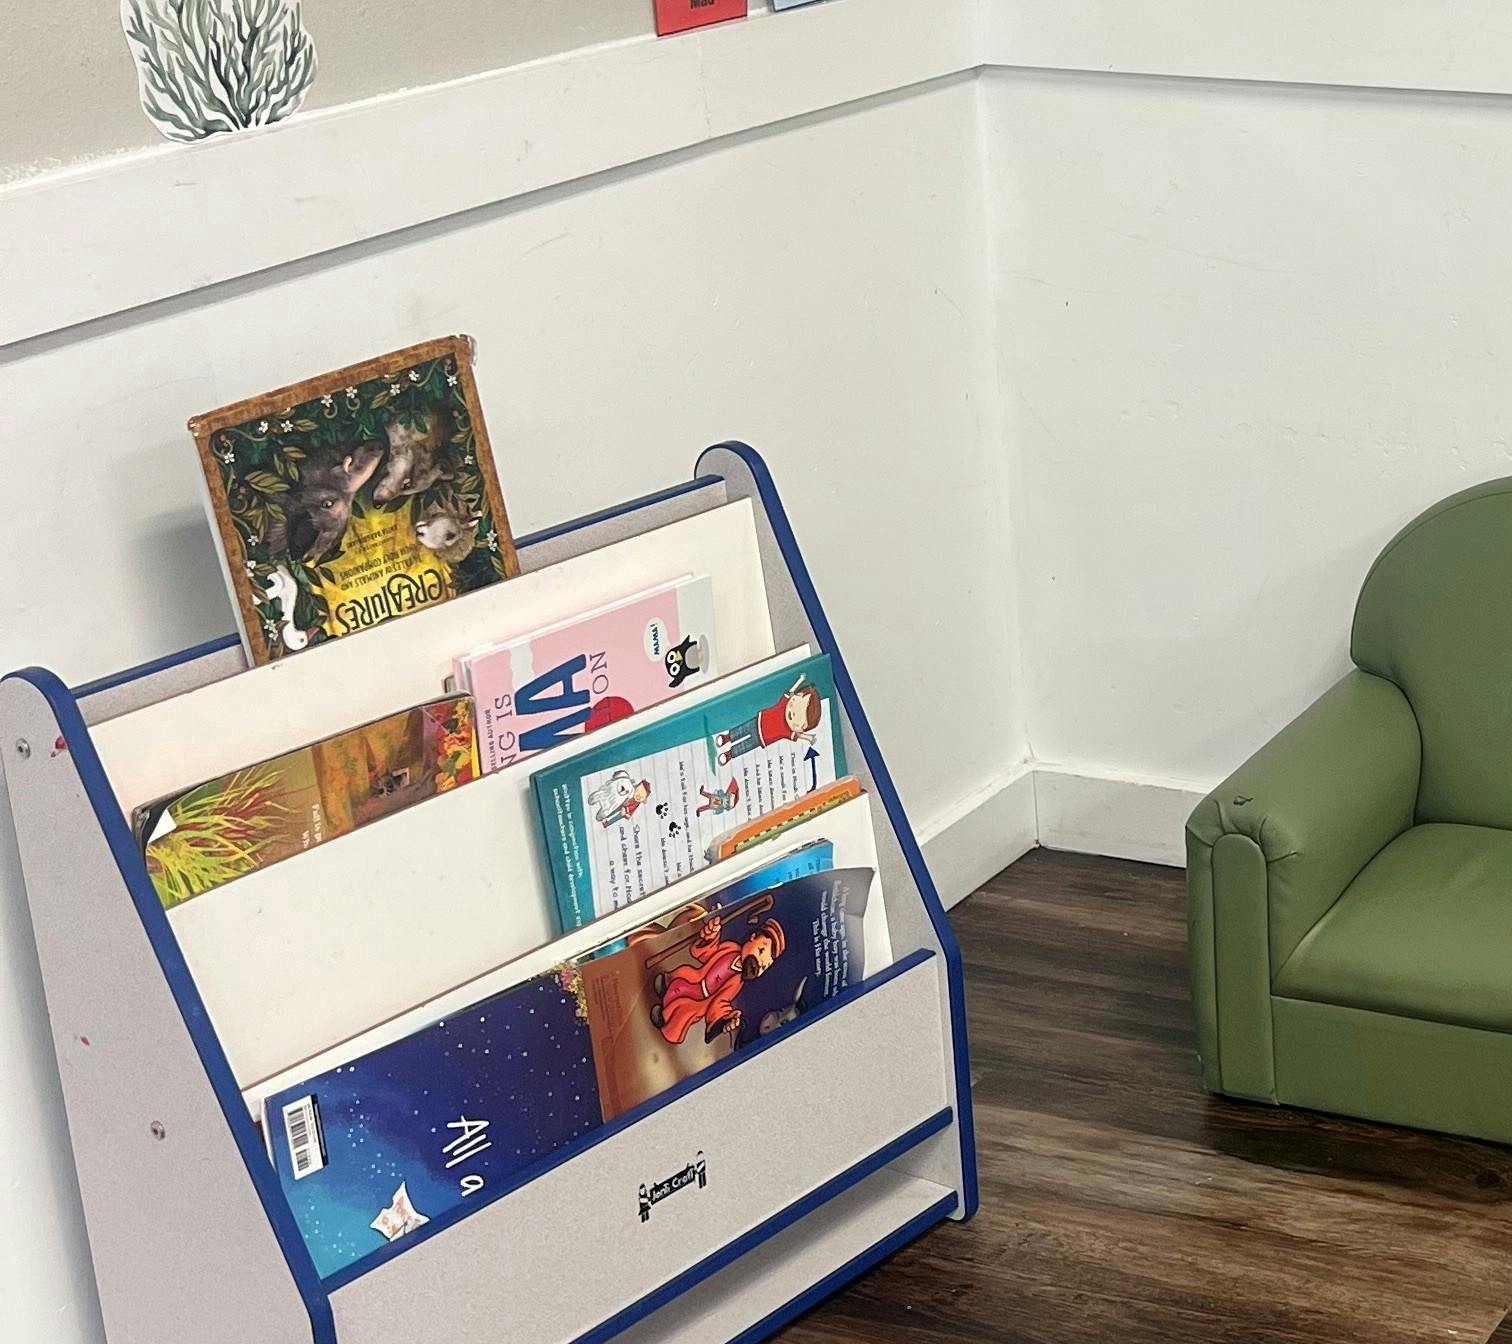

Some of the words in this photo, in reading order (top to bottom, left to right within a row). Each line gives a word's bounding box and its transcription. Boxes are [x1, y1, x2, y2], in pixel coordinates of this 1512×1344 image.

[335, 568, 444, 636] CREATURES
[649, 623, 661, 656] MAMA!
[590, 651, 610, 695] ON
[495, 693, 514, 721] IS
[618, 826, 626, 840] and
[623, 869, 631, 882] for
[442, 1114, 492, 1169] All
[459, 1174, 485, 1197] a
